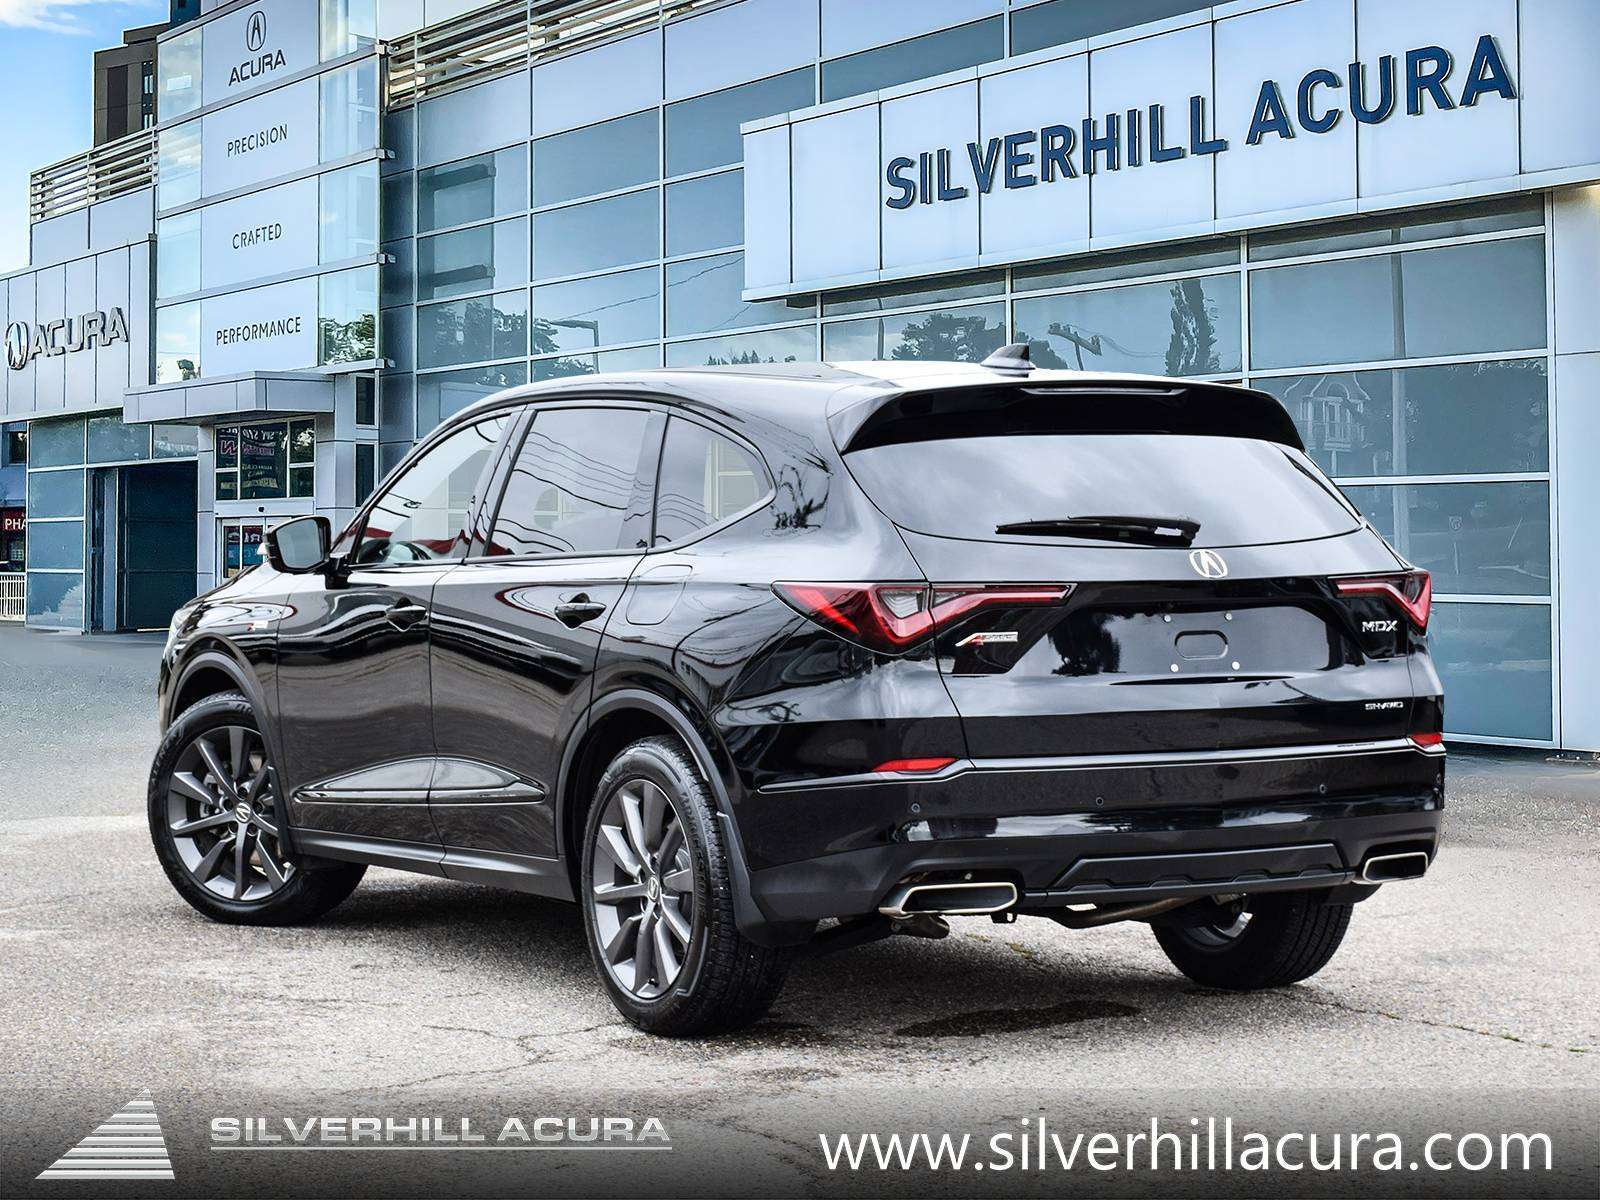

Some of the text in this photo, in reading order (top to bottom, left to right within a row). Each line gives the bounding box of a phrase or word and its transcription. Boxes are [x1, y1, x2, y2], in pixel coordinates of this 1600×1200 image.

[228, 49, 286, 87] ACURA
[885, 34, 1517, 210] SILVERHILL ACURA
[227, 124, 288, 157] PRECISION
[232, 223, 282, 249] CRAFTED
[28, 306, 129, 360] ACURA
[216, 316, 301, 346] PERFORMANCE
[1361, 620, 1398, 632] MDX
